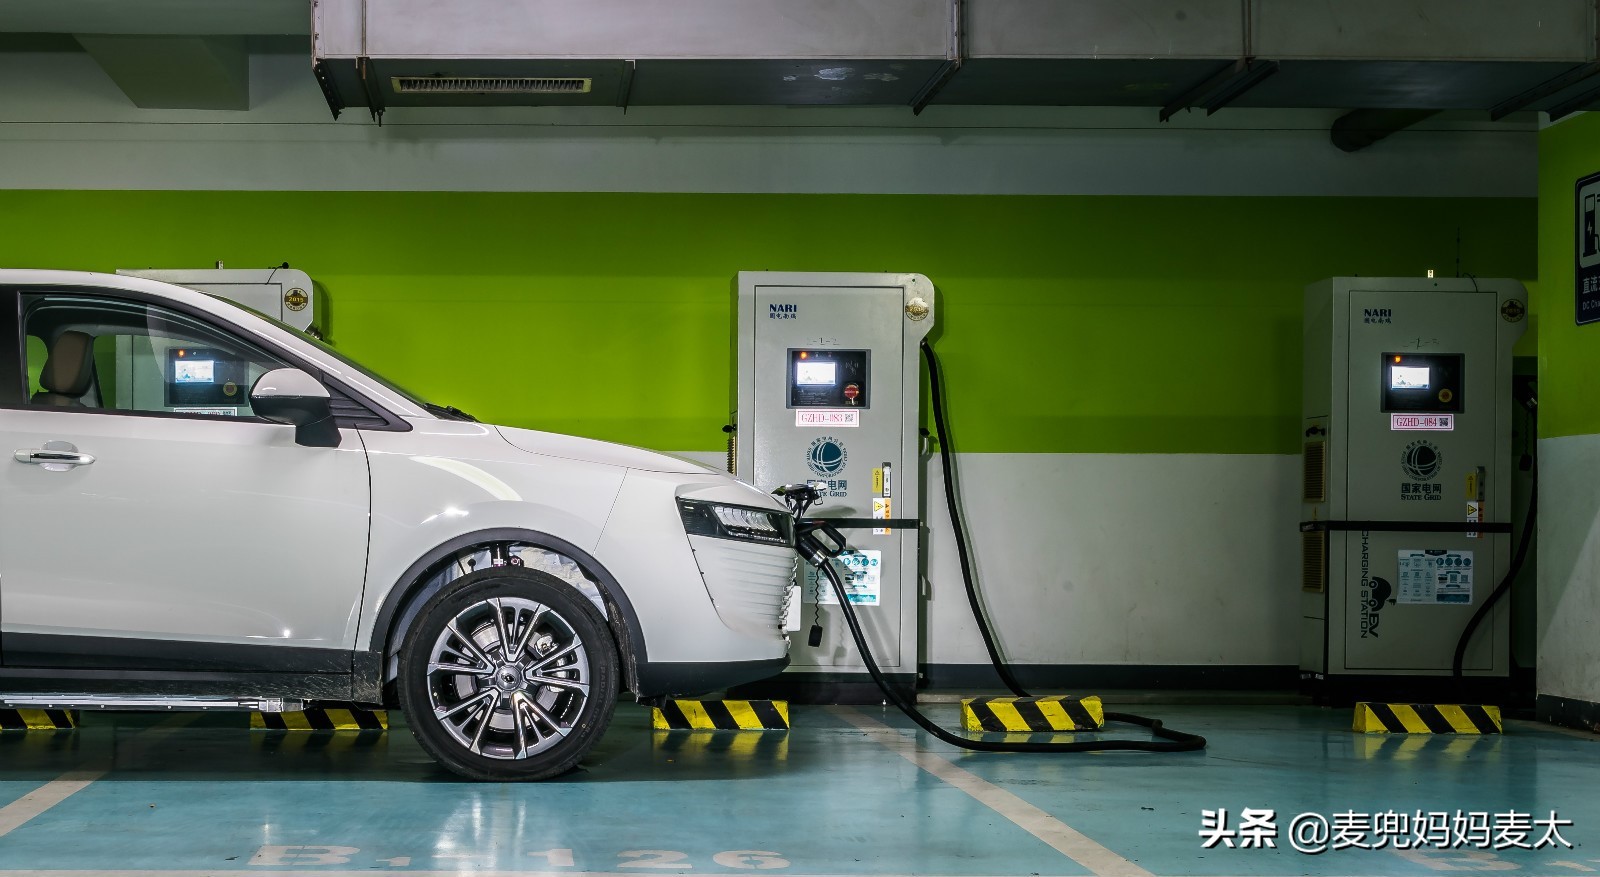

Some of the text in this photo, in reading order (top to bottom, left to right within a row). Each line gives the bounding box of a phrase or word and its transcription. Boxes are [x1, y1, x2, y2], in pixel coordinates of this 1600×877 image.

[1582, 275, 1600, 294] 直流
[769, 304, 797, 312] NARI
[1364, 308, 1392, 317] NARI
[1396, 417, 1437, 427] GZHD-084
[1401, 482, 1442, 494] 国家电网
[1401, 493, 1442, 501] STATE GRID
[1361, 530, 1369, 639] CHARGING STATION
[1369, 613, 1380, 638] EV
